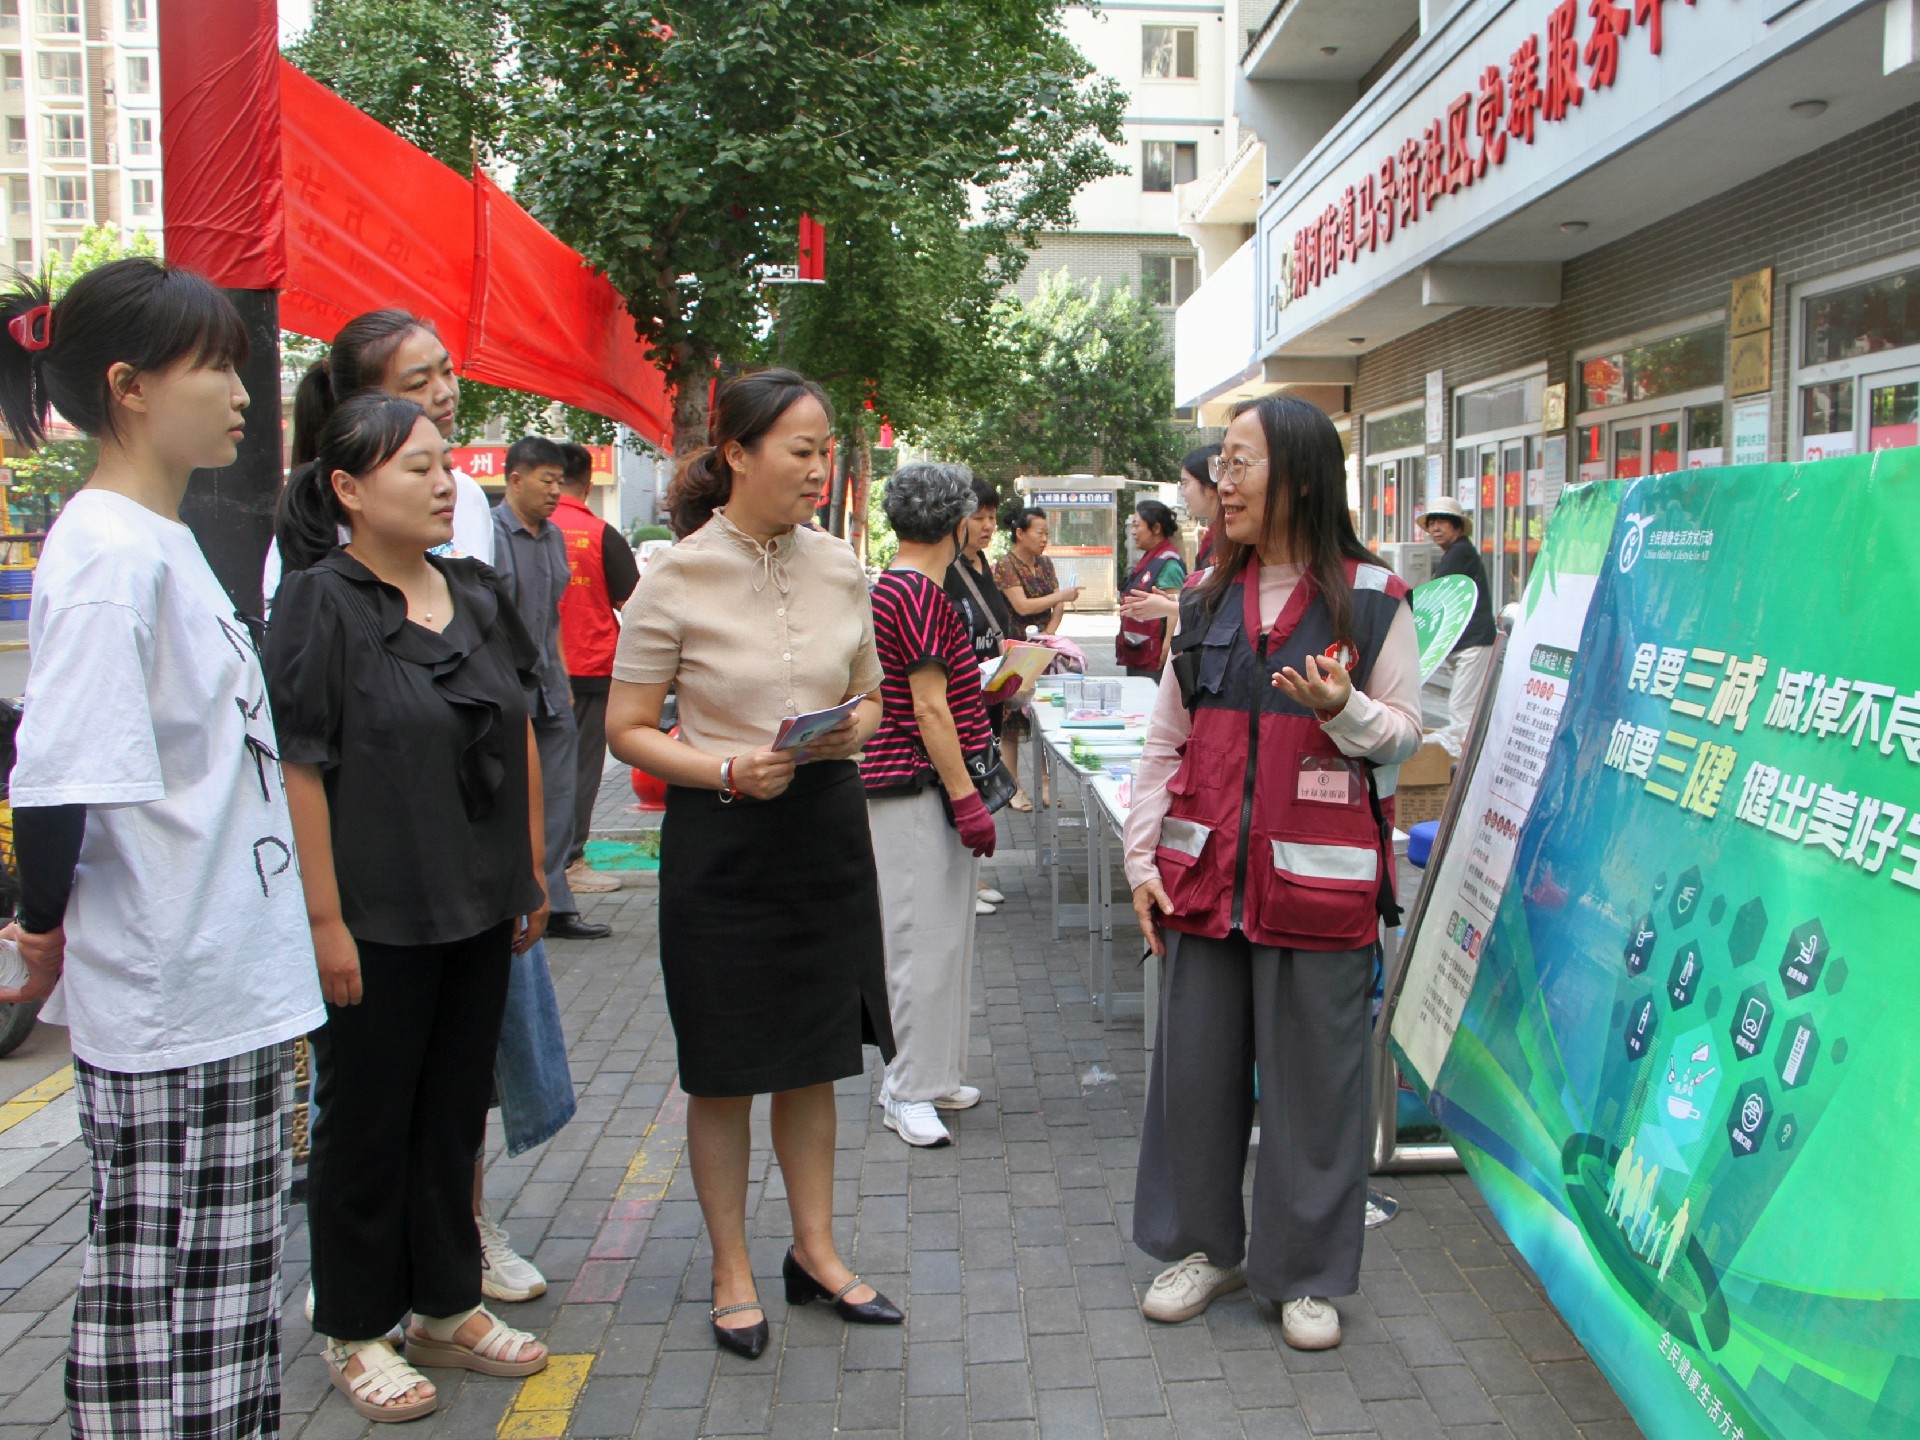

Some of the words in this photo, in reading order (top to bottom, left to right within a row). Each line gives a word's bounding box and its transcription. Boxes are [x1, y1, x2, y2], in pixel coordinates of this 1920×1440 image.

[1647, 529, 1714, 547] 全民健康生活方式行动
[1627, 641, 1769, 733] 食要三减
[1762, 666, 1920, 764] 减掉不良
[1603, 717, 1738, 820] 体要三健
